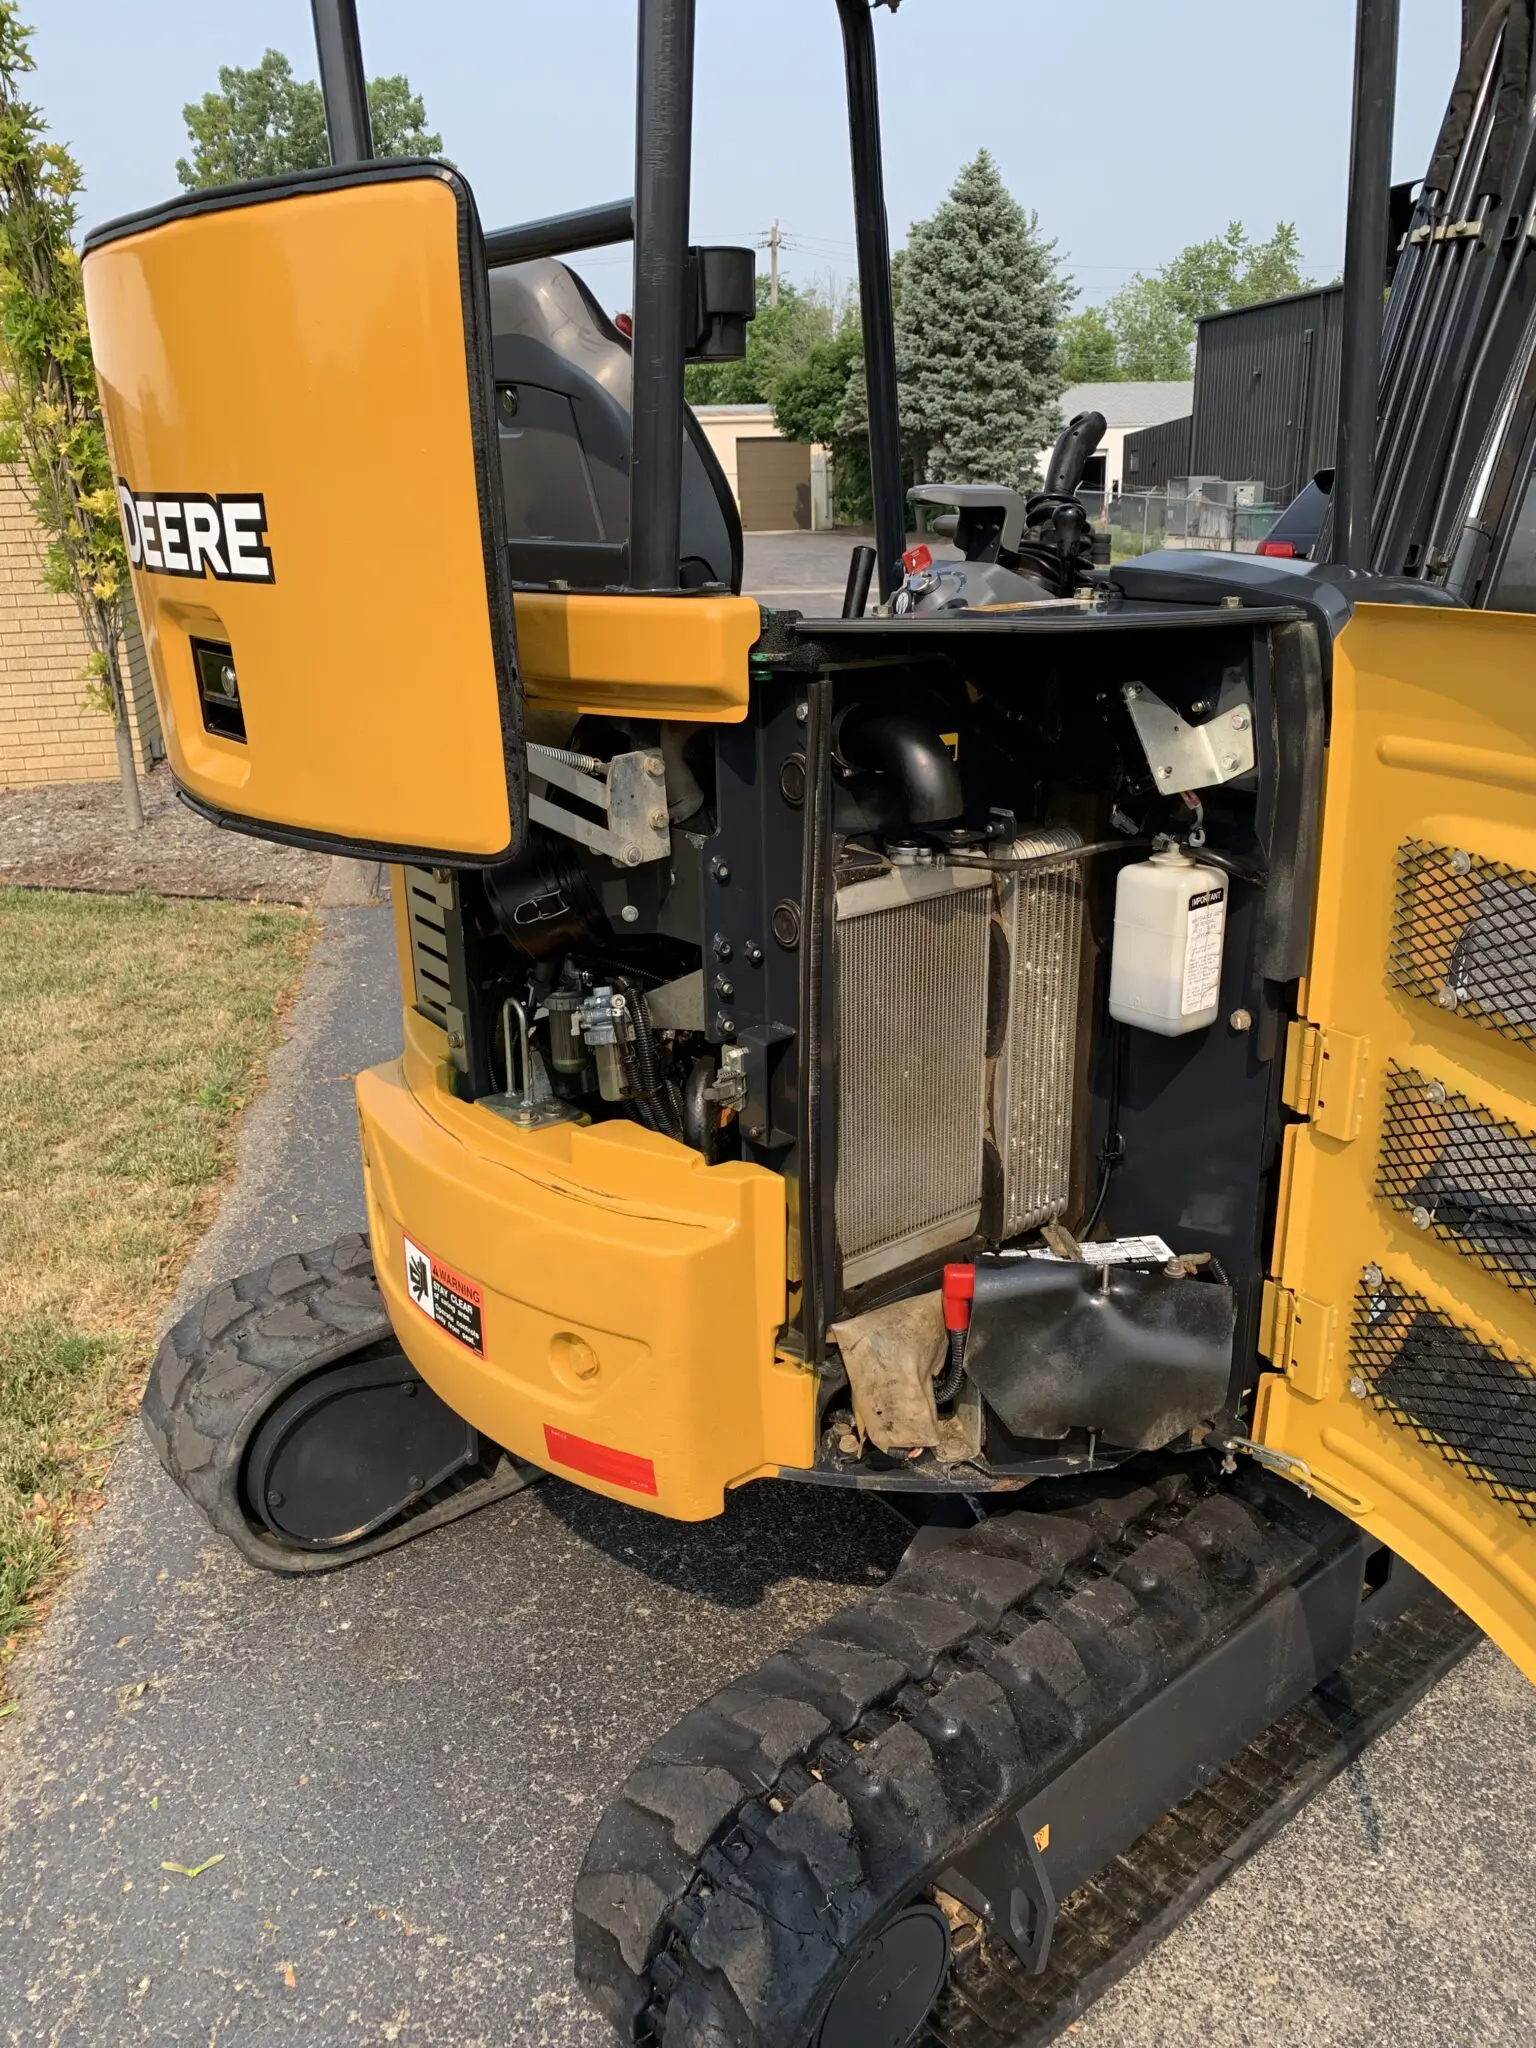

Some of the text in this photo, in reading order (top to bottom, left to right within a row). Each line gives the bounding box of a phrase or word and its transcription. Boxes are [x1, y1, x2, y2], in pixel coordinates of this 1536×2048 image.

[118, 484, 270, 577] DEERE
[1191, 890, 1222, 907] IMPORANT
[433, 1280, 473, 1315] STAY CLEAR
[439, 1267, 480, 1303] WARNING
